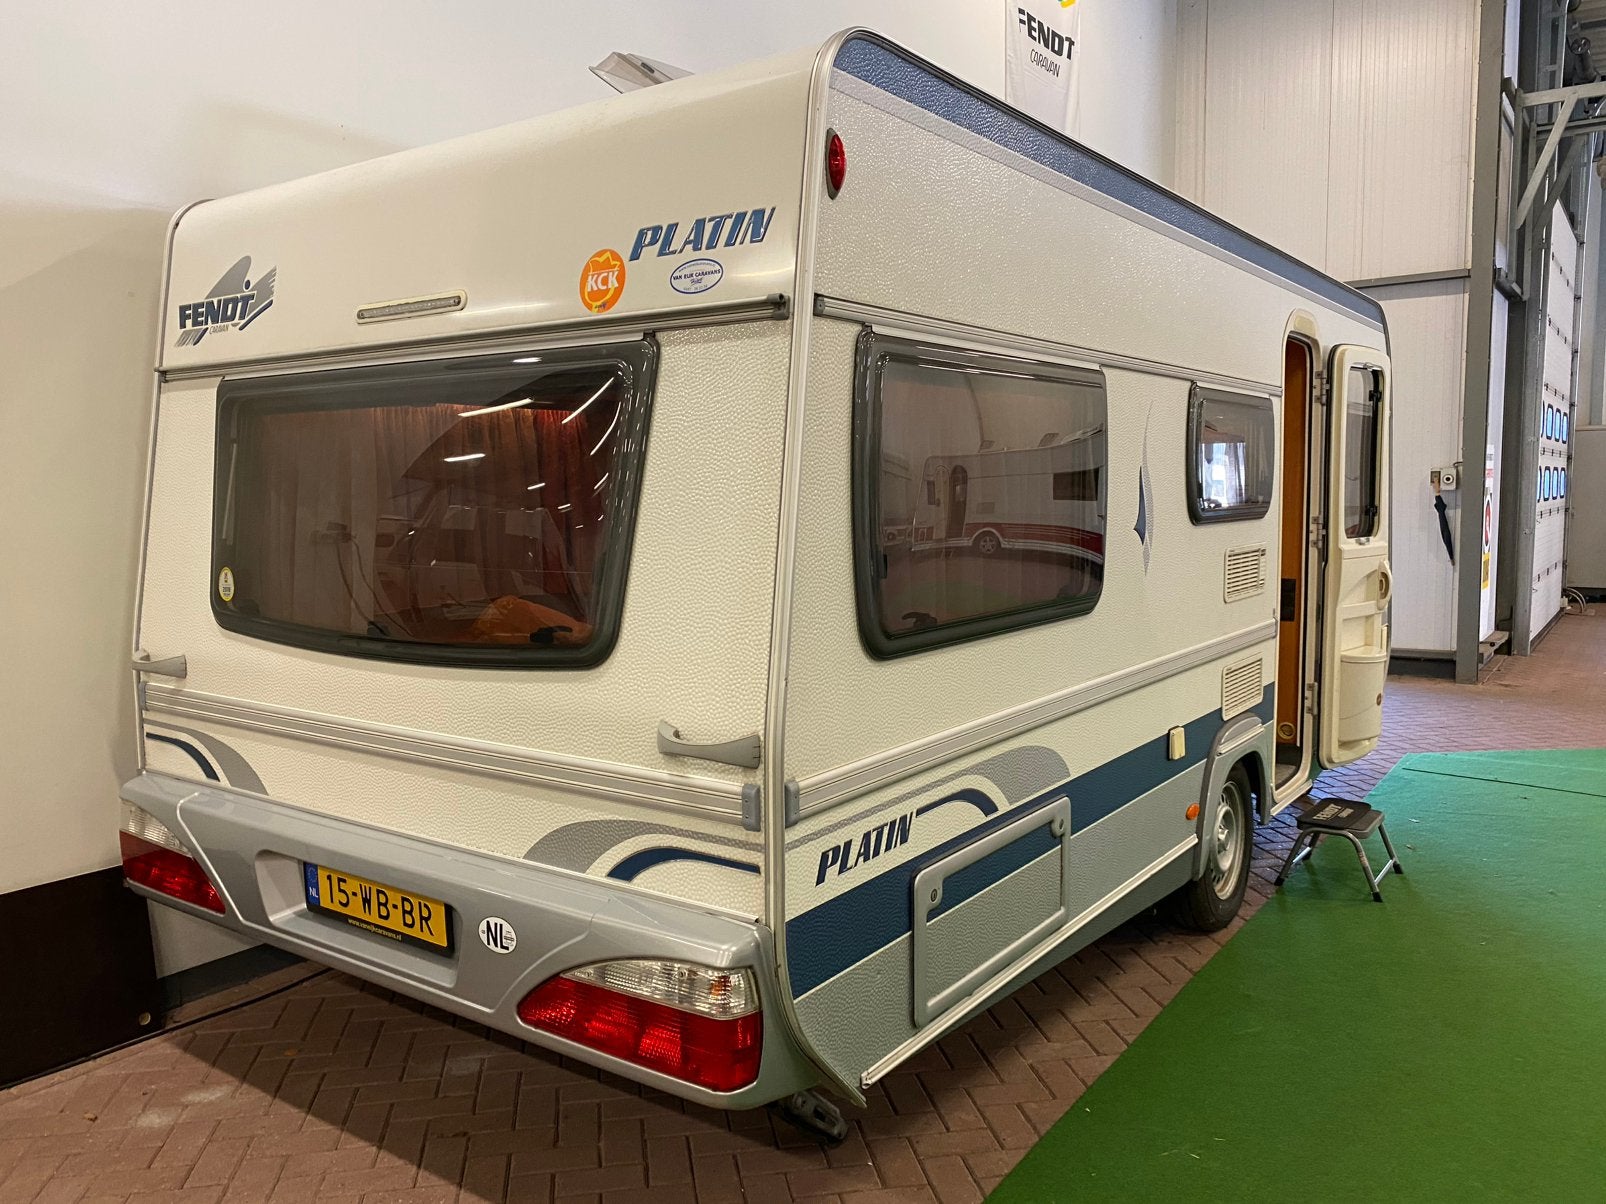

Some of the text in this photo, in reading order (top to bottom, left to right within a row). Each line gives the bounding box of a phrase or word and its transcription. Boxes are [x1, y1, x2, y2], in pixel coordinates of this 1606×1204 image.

[1018, 8, 1075, 60] FENDT
[1030, 48, 1060, 78] CARAVAN
[629, 206, 776, 262] PLATIN
[587, 270, 619, 292] KCK
[695, 269, 721, 277] CARAVANS
[179, 293, 256, 330] FENDT
[815, 811, 913, 887] PLATIN
[309, 886, 319, 898] NL
[326, 874, 435, 937] 15-WB-BR
[486, 920, 509, 951] NL
